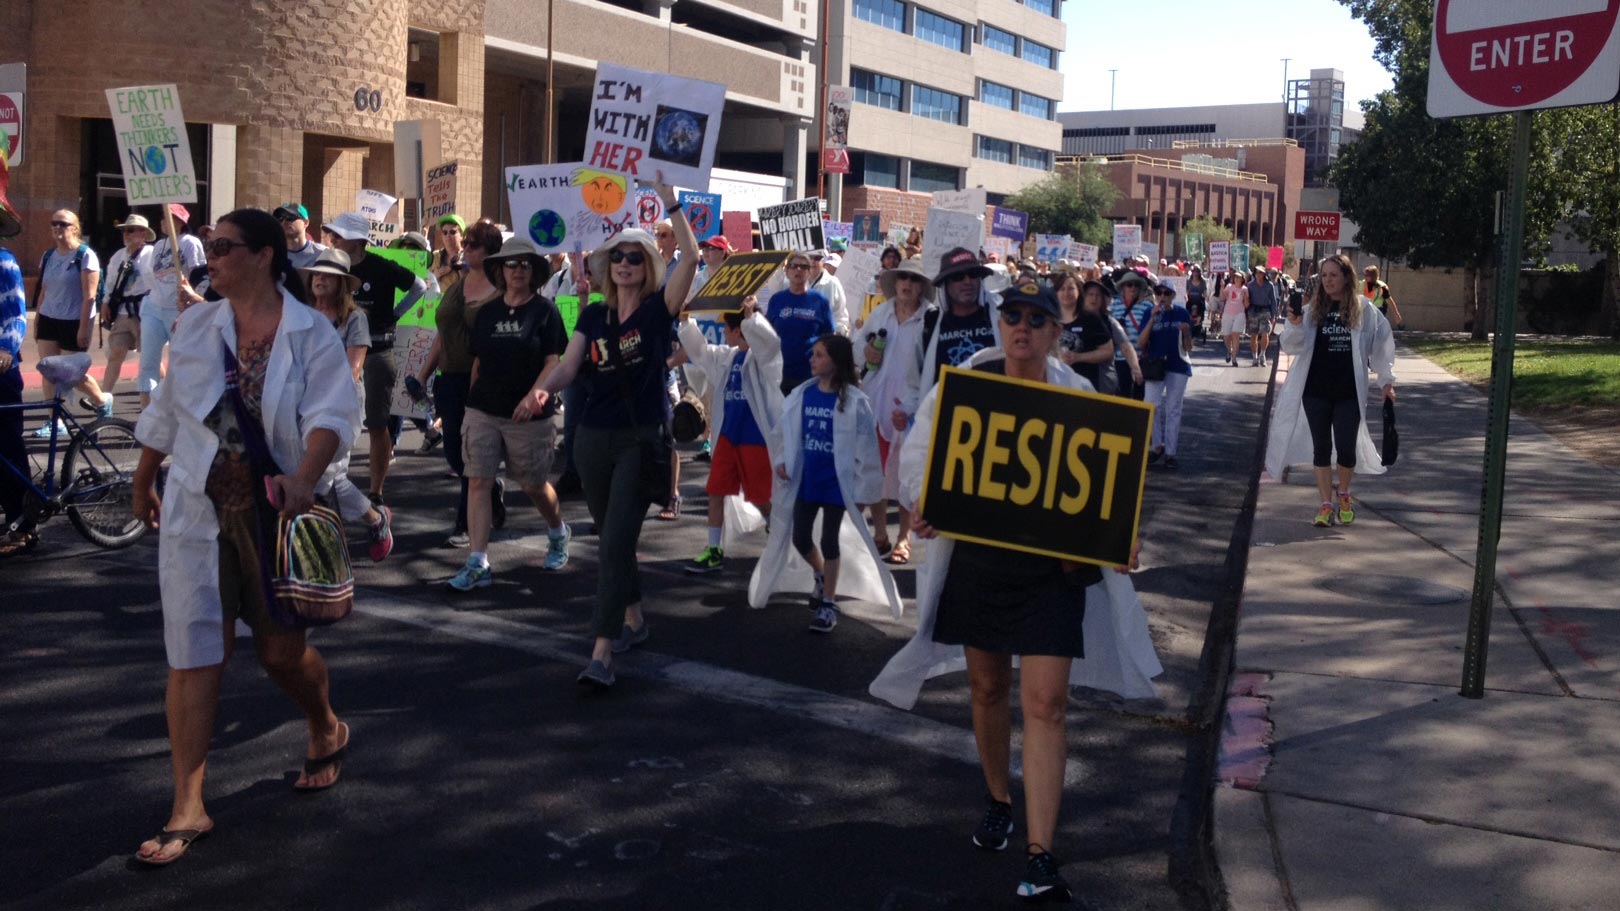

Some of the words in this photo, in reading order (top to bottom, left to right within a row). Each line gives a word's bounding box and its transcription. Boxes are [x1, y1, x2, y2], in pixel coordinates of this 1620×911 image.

[1470, 30, 1575, 71] ENTER
[116, 88, 174, 113] EARTH
[354, 87, 382, 112] 60
[597, 80, 642, 103] I'M
[131, 113, 166, 129] NEEDS
[594, 108, 651, 142] WITH
[120, 127, 179, 147] THINKERS
[128, 144, 179, 176] NOT
[589, 141, 643, 175] HER
[129, 175, 192, 200] DENIERS
[518, 176, 570, 190] EARTH
[427, 200, 456, 219] TRUTH
[684, 193, 714, 205] SCIENCE
[762, 218, 777, 236] NO
[778, 211, 820, 231] BORDER
[999, 212, 1022, 227] THINK
[1300, 215, 1336, 226] WRONG
[1306, 226, 1328, 236] WAY
[771, 228, 815, 252] WALL
[697, 262, 777, 297] RESIST
[940, 329, 973, 341] MARCH
[1322, 323, 1351, 335] SCIENC
[941, 405, 1132, 520] RESIST
